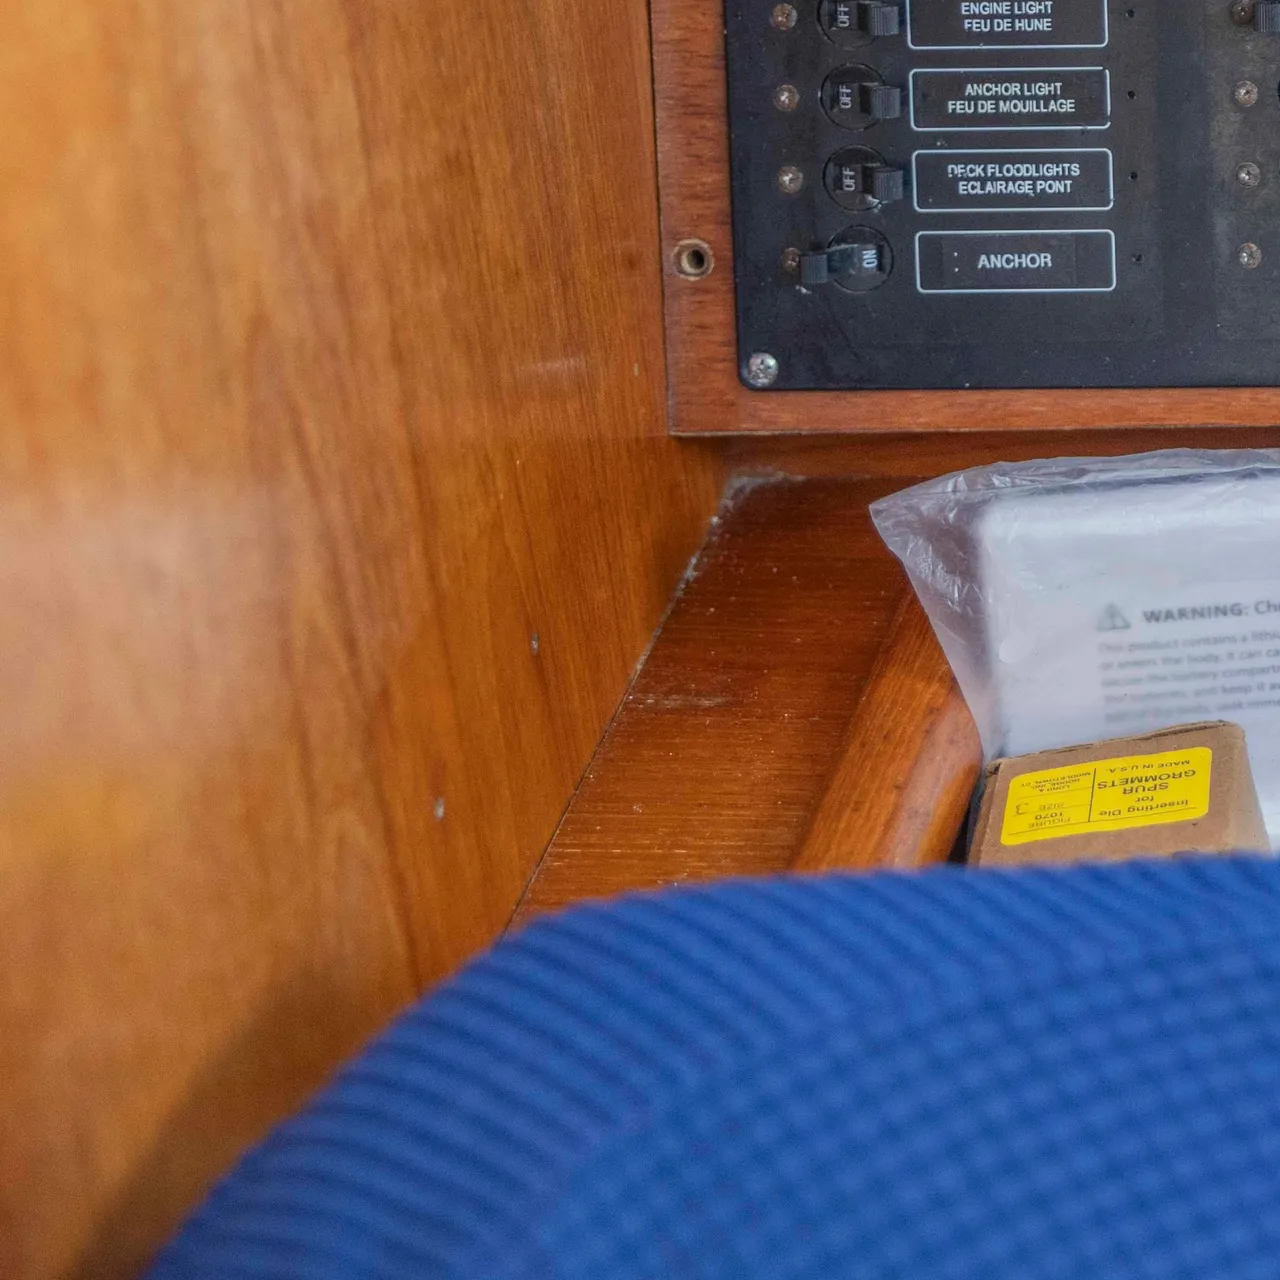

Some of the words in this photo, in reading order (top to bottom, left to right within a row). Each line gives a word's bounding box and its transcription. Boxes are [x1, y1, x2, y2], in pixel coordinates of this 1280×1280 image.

[962, 2, 1011, 14] ENGINE
[1015, 1, 1053, 14] LIGHT
[964, 19, 990, 31] FEU
[994, 19, 1012, 31] DE
[1015, 18, 1052, 31] HUNE
[965, 83, 1021, 96] ANCHOR
[1024, 83, 1062, 95] LIGHT
[948, 101, 974, 113] FEU
[978, 101, 996, 113] DE
[999, 99, 1075, 113] MOUILLAGE
[978, 253, 1052, 268] ANCHOR
[1142, 602, 1249, 624] WARNING:
[1161, 759, 1190, 768] MADE
[1098, 769, 1196, 790] GROMMETS
[1122, 782, 1168, 794] SPUR
[1099, 809, 1120, 817] Die
[1127, 800, 1188, 813] Inserting
